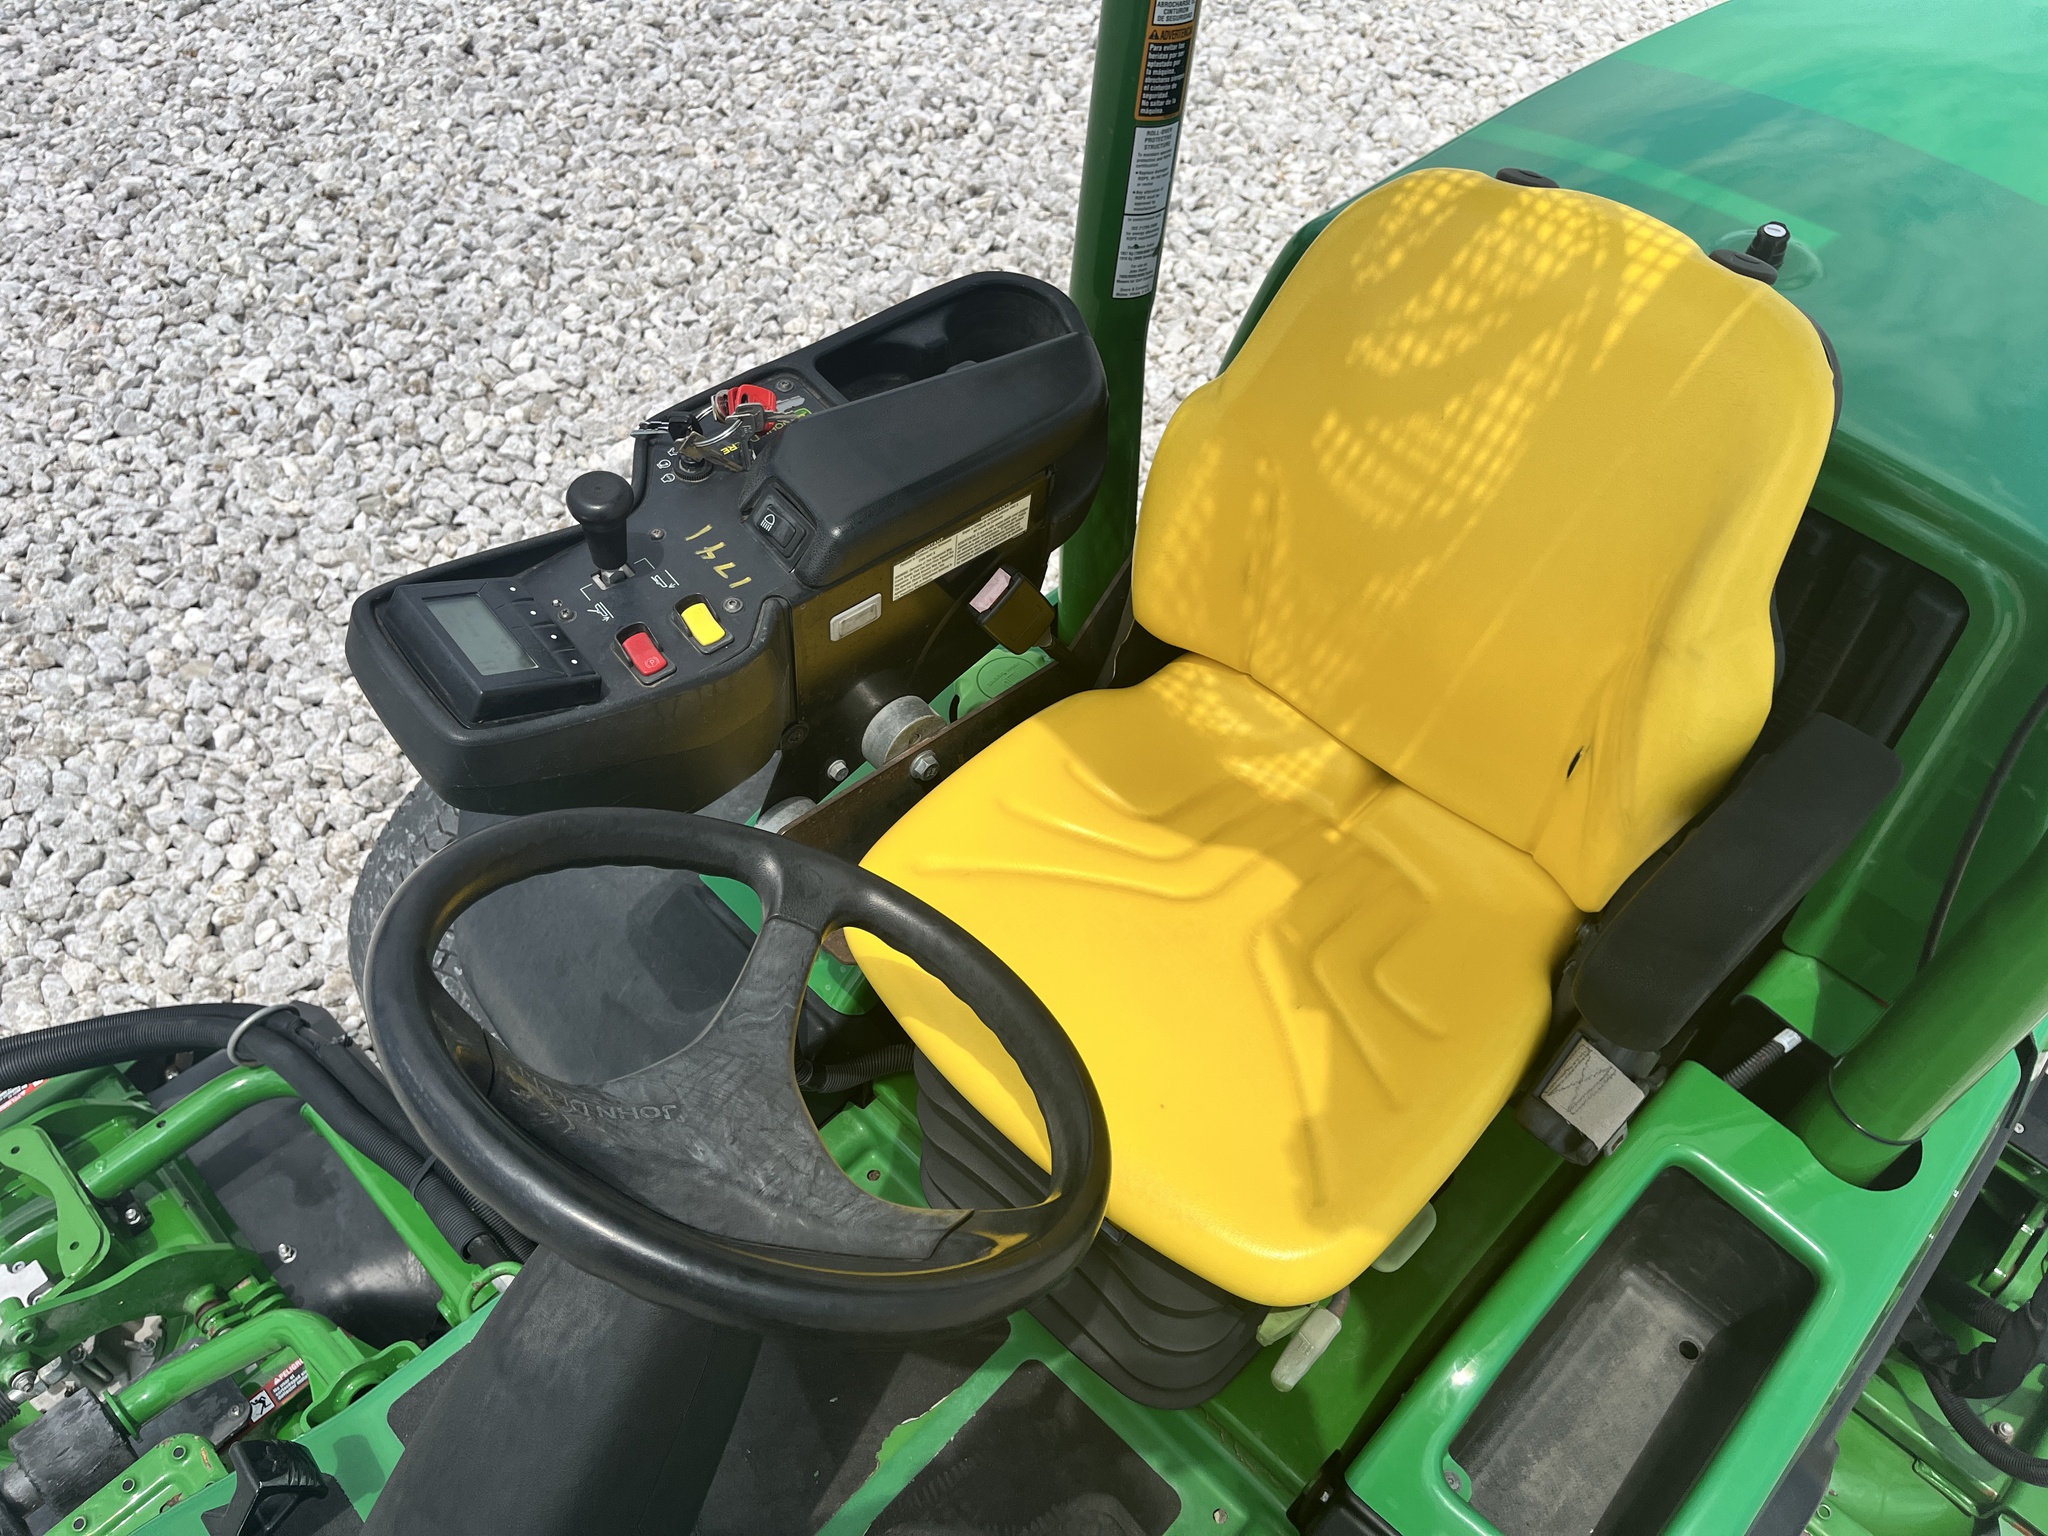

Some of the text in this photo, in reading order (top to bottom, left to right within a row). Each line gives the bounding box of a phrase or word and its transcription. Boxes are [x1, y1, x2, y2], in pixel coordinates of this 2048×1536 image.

[1149, 43, 1163, 52] Para
[1148, 51, 1169, 60] heridas
[1147, 60, 1173, 69] aplastado
[596, 1103, 678, 1121] JOHN
